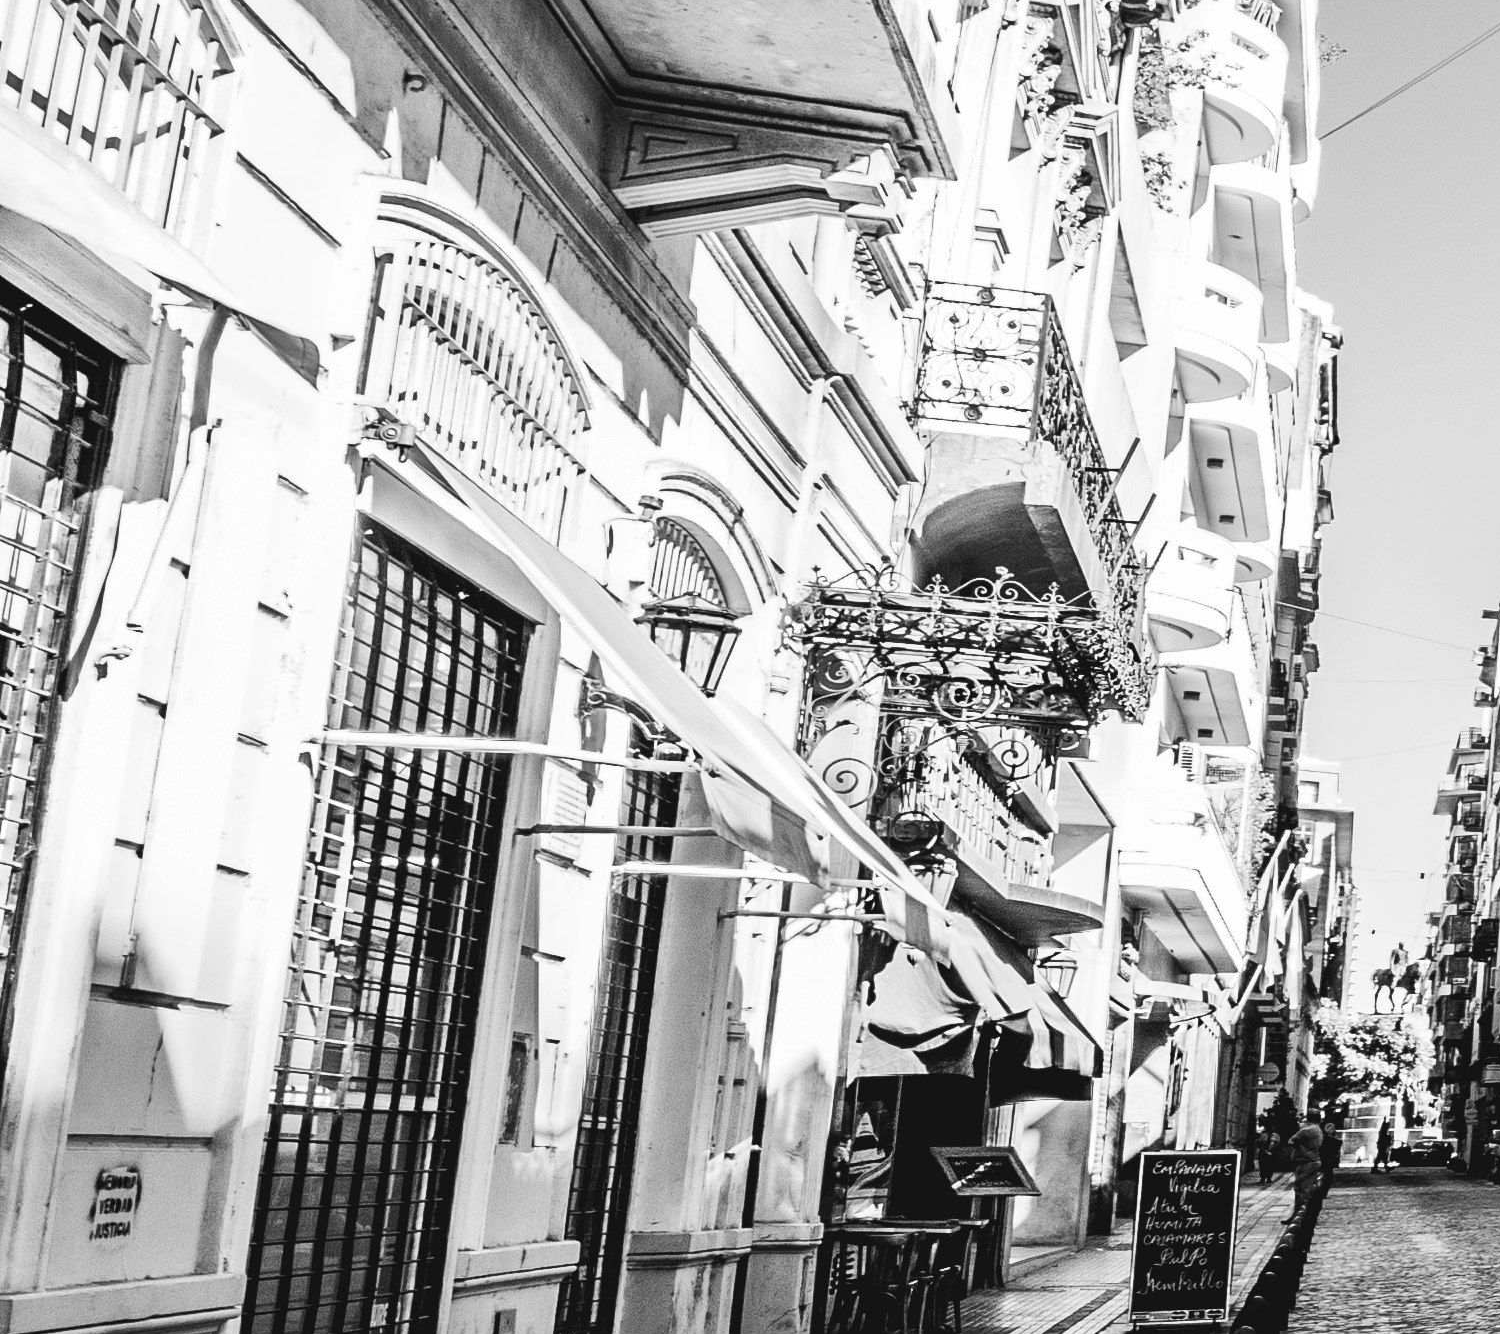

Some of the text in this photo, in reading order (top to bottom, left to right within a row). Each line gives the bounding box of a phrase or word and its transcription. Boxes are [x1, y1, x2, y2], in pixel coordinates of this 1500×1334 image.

[1168, 1176, 1221, 1205] Vigilia
[99, 1197, 133, 1215] VERDAD
[94, 1220, 131, 1239] JUSTICIA
[1143, 1232, 1227, 1247] CALAMARES
